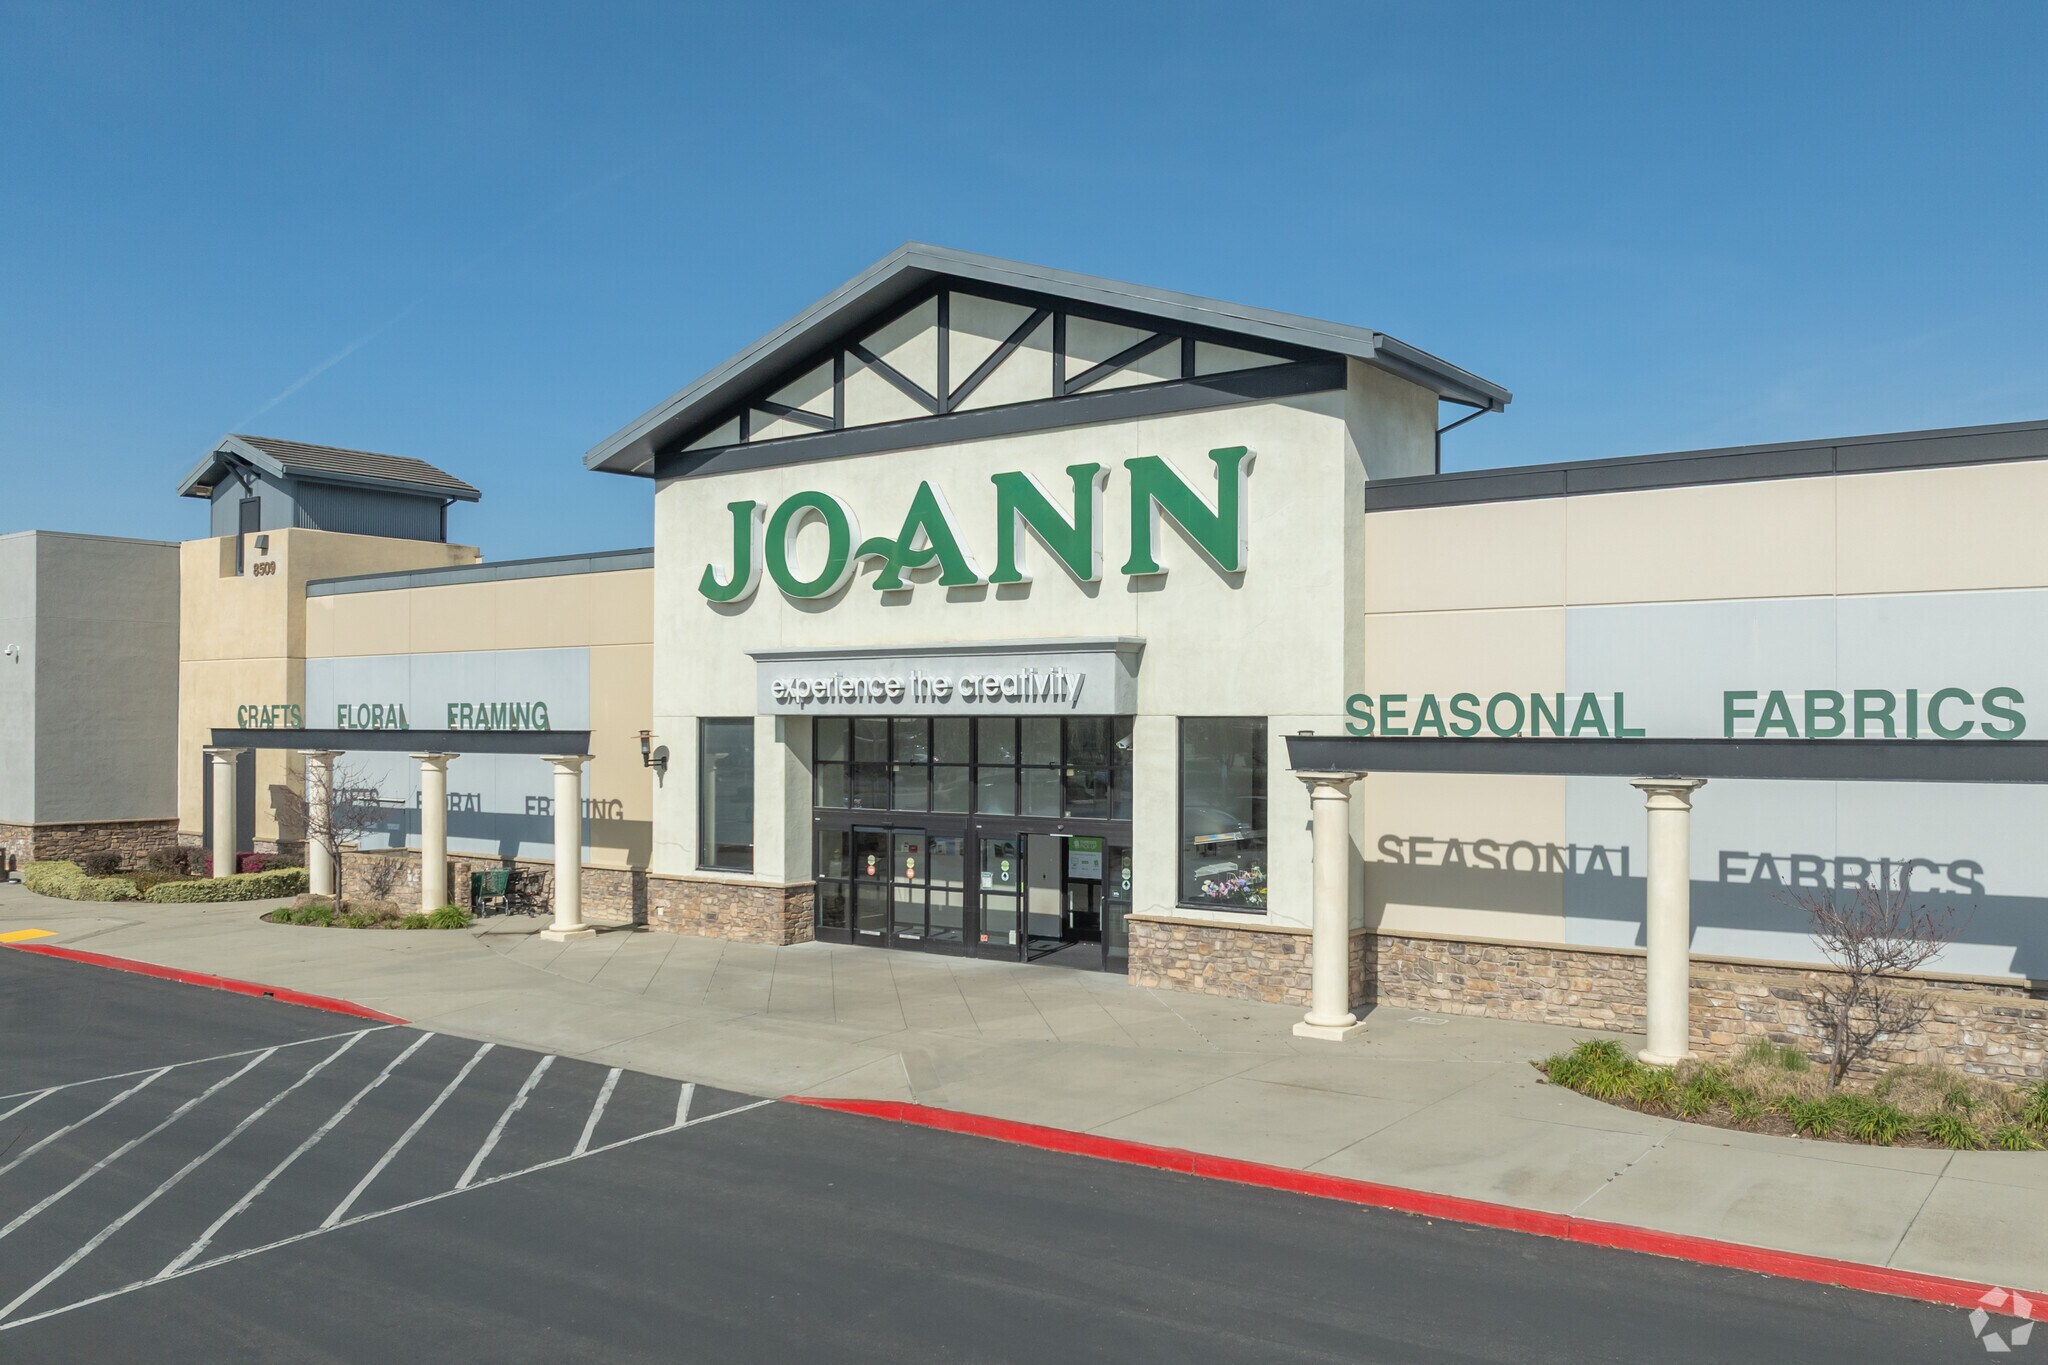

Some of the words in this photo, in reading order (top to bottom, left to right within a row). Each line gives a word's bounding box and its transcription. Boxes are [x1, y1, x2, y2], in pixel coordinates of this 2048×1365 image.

[253, 561, 276, 577] 8509
[771, 672, 904, 705] experience
[910, 669, 952, 698] the
[958, 666, 1085, 702] creativity
[237, 704, 304, 729] CRAFTS
[337, 703, 409, 730] FLORAL
[447, 701, 548, 730] FRAMING
[1345, 692, 1646, 737] SEASONAL
[1723, 687, 2027, 740] FABRICS
